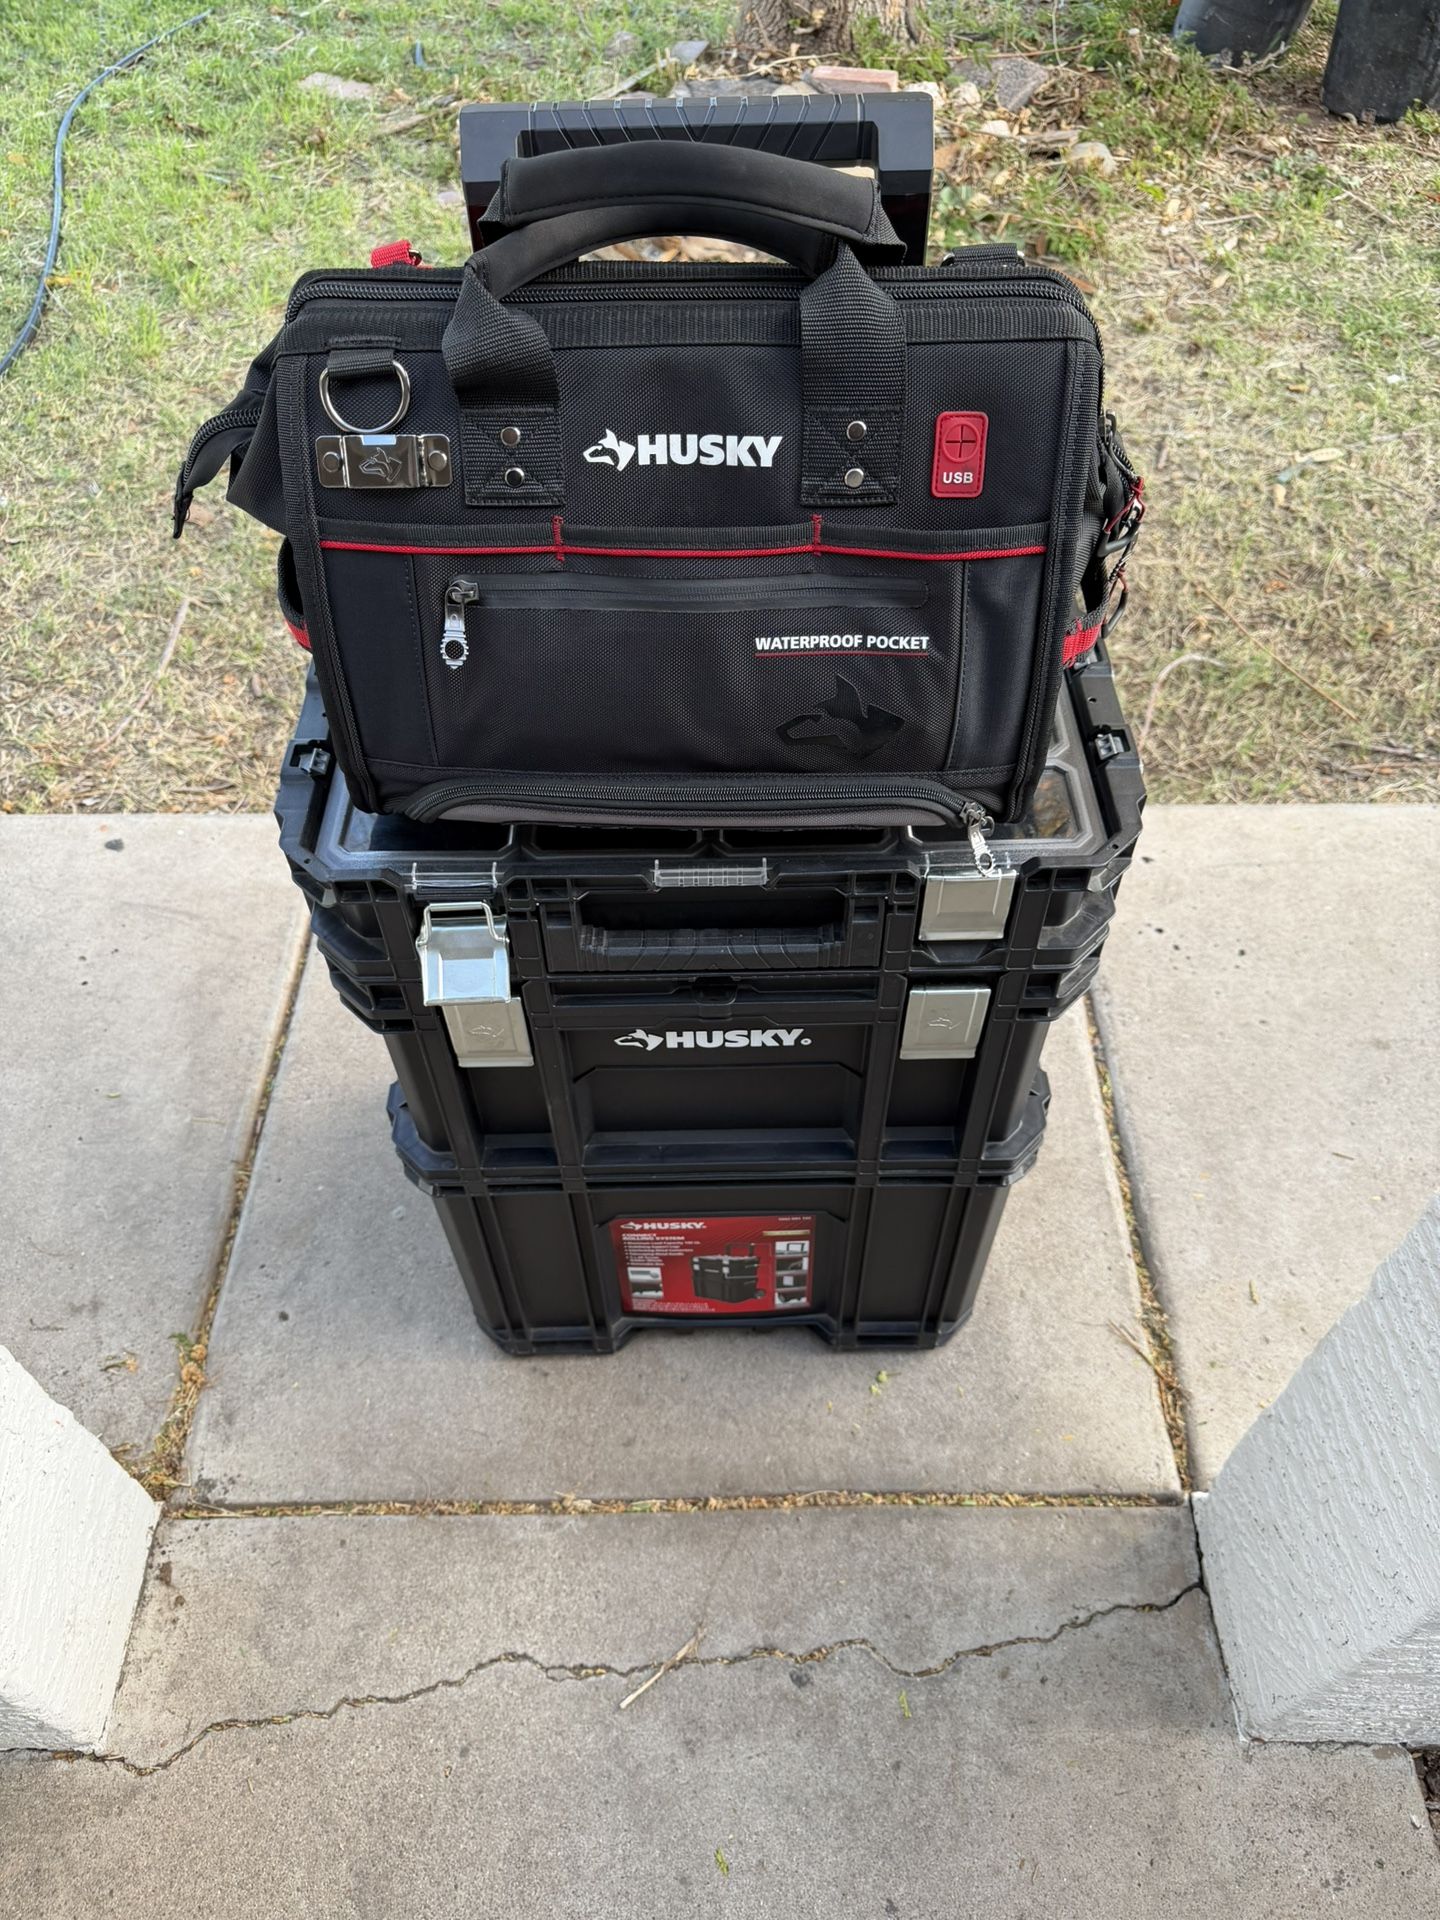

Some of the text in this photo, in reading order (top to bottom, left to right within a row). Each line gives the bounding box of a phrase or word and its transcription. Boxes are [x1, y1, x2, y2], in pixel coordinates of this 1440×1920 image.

[637, 433, 784, 467] HUSKY
[942, 471, 974, 484] USB
[754, 634, 930, 650] WATERPROOF POCKET
[665, 1028, 804, 1048] HUSKY
[642, 1222, 705, 1230] HUSKY
